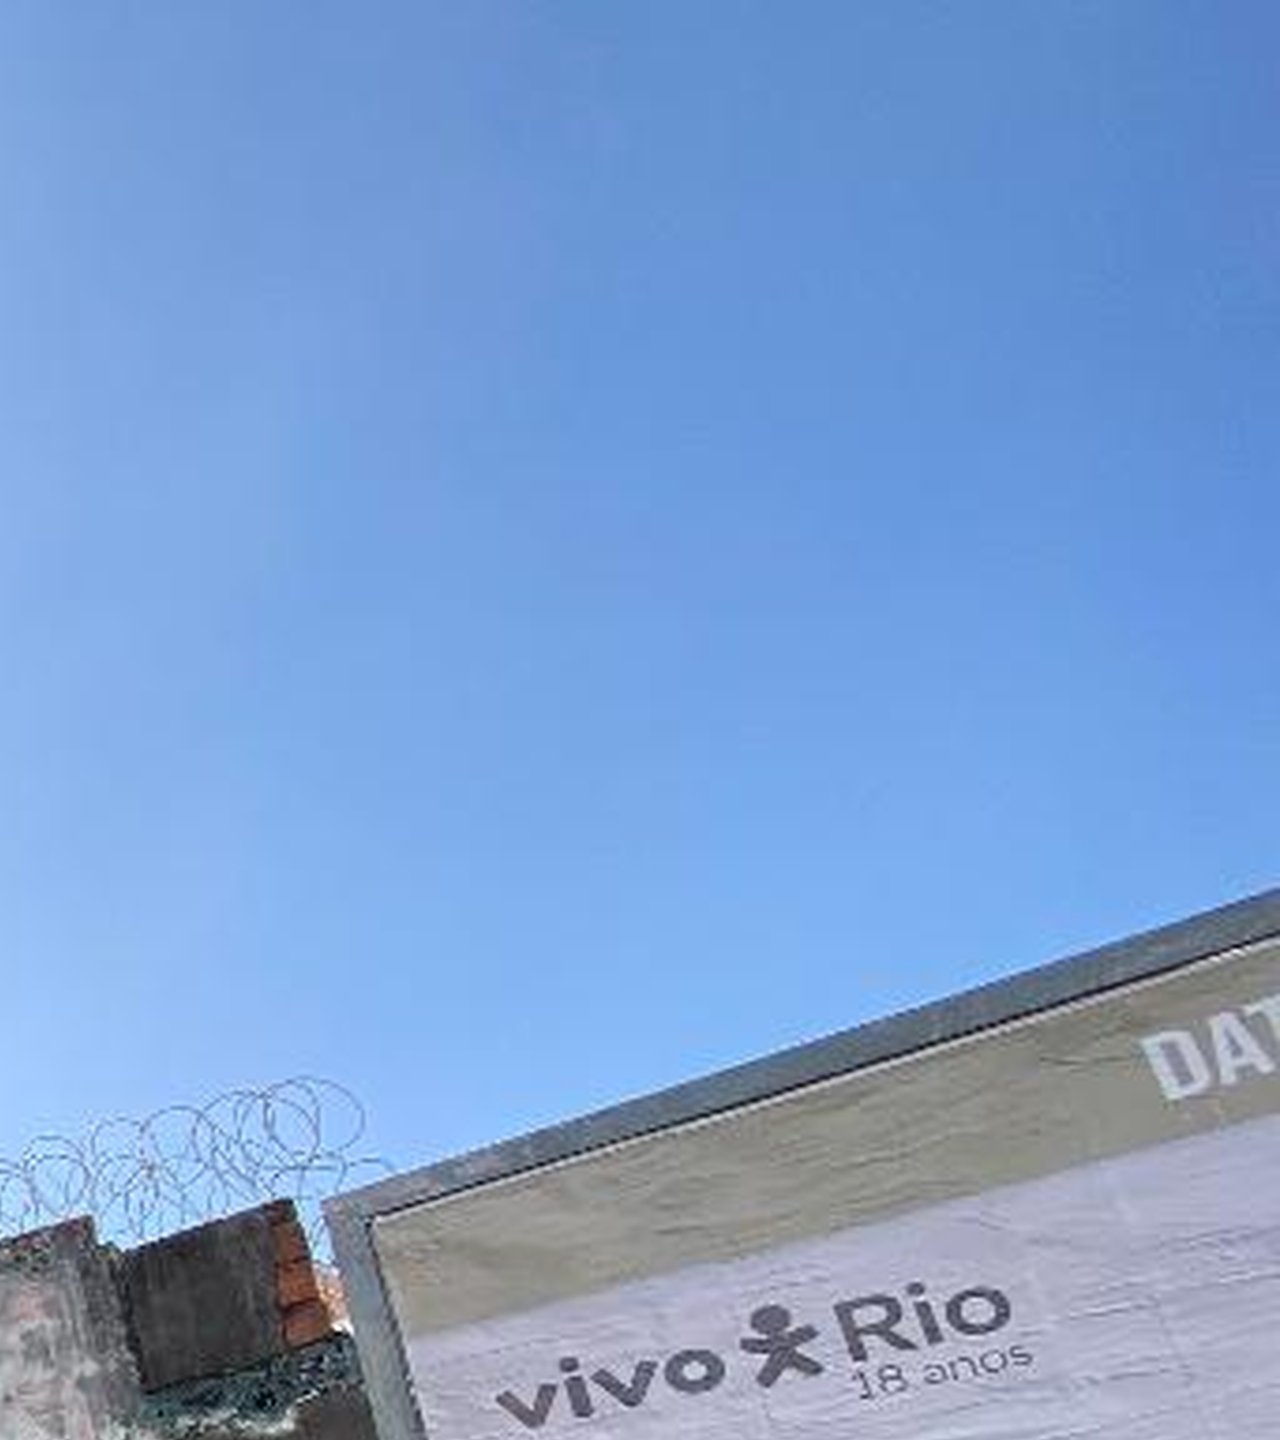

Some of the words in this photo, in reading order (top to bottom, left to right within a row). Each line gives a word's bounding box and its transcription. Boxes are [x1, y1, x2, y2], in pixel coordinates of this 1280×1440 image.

[495, 1349, 726, 1430] vivo
[834, 1282, 1013, 1362] Rio
[850, 1363, 909, 1401] 18
[923, 1342, 1034, 1386] anos
